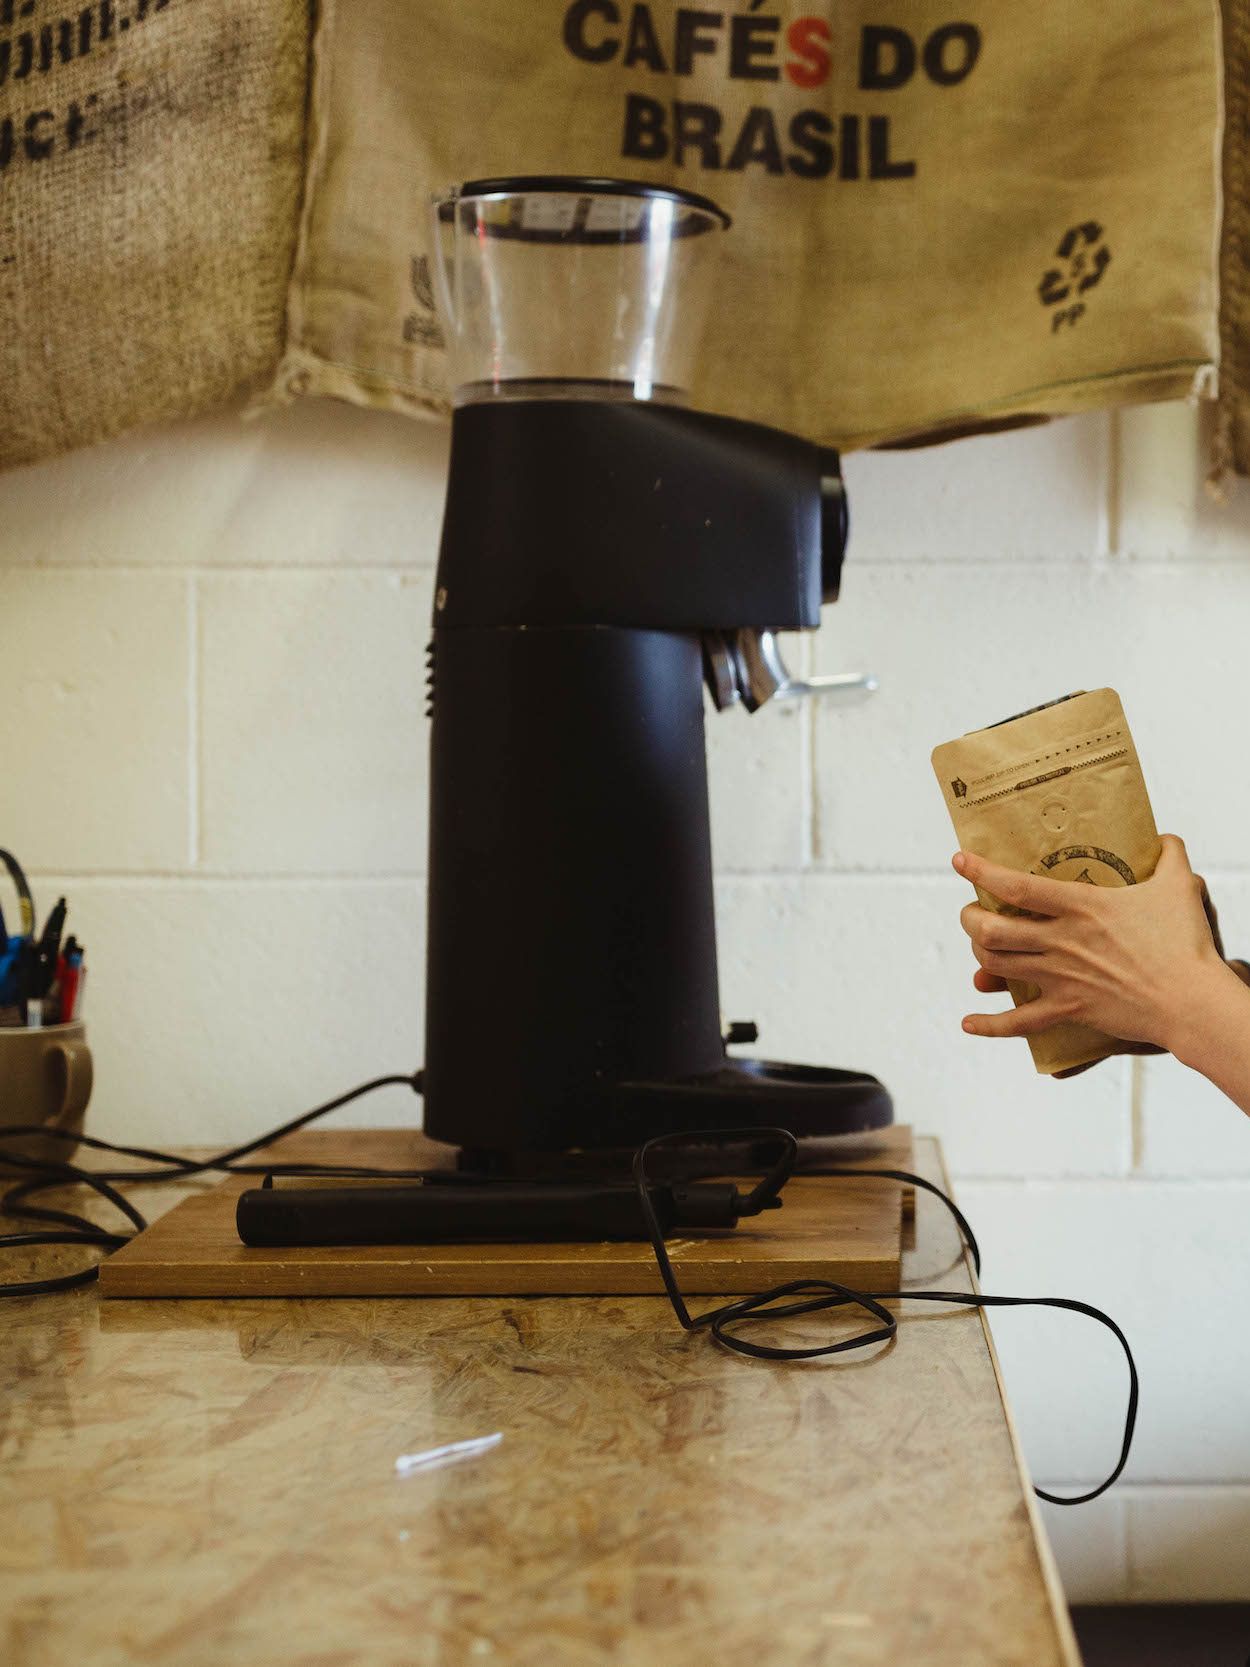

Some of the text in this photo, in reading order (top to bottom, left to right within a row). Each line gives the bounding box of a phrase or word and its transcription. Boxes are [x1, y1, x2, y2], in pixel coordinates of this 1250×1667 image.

[563, 0, 982, 91] CAFÉS DO
[621, 93, 916, 181] BRASIL
